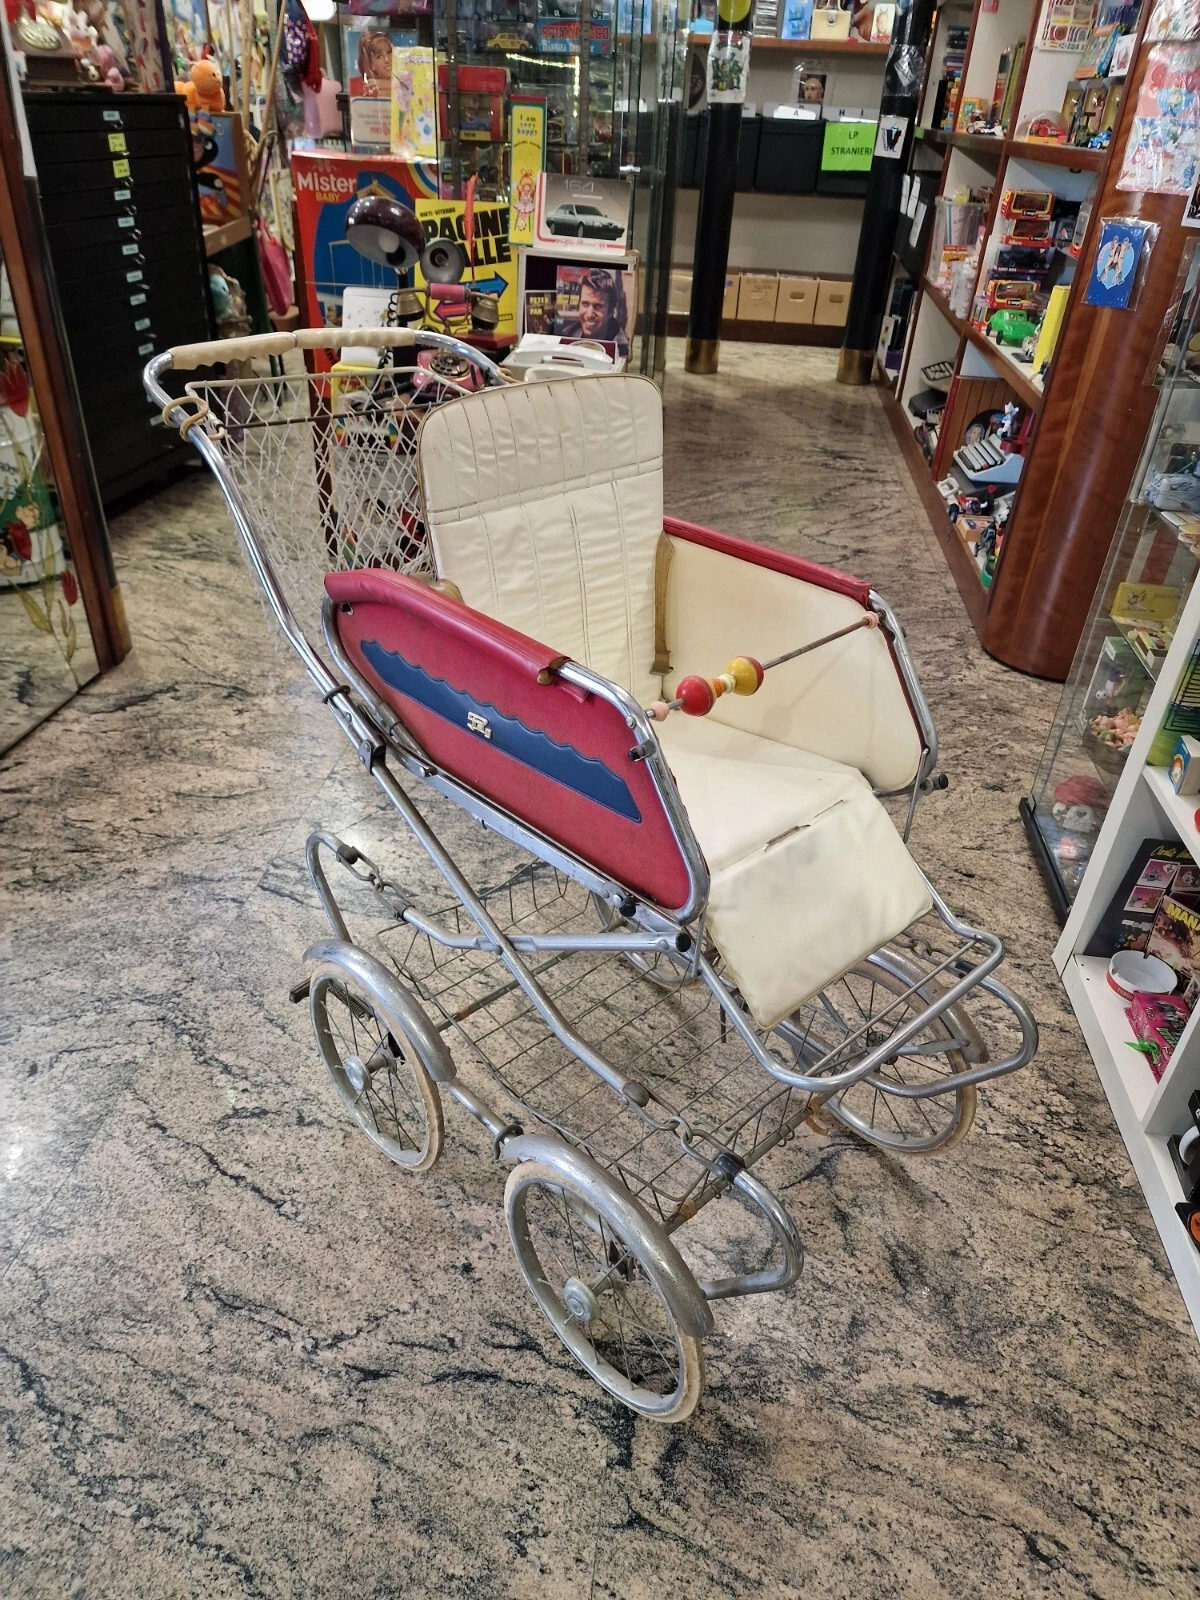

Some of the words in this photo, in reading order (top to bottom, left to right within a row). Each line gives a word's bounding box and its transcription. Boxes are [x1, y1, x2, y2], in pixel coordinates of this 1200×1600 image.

[848, 131, 859, 140] LP
[830, 147, 873, 156] STRANIERI
[296, 171, 358, 194] Mister
[315, 191, 341, 203] BABY
[529, 307, 543, 316] PAN
